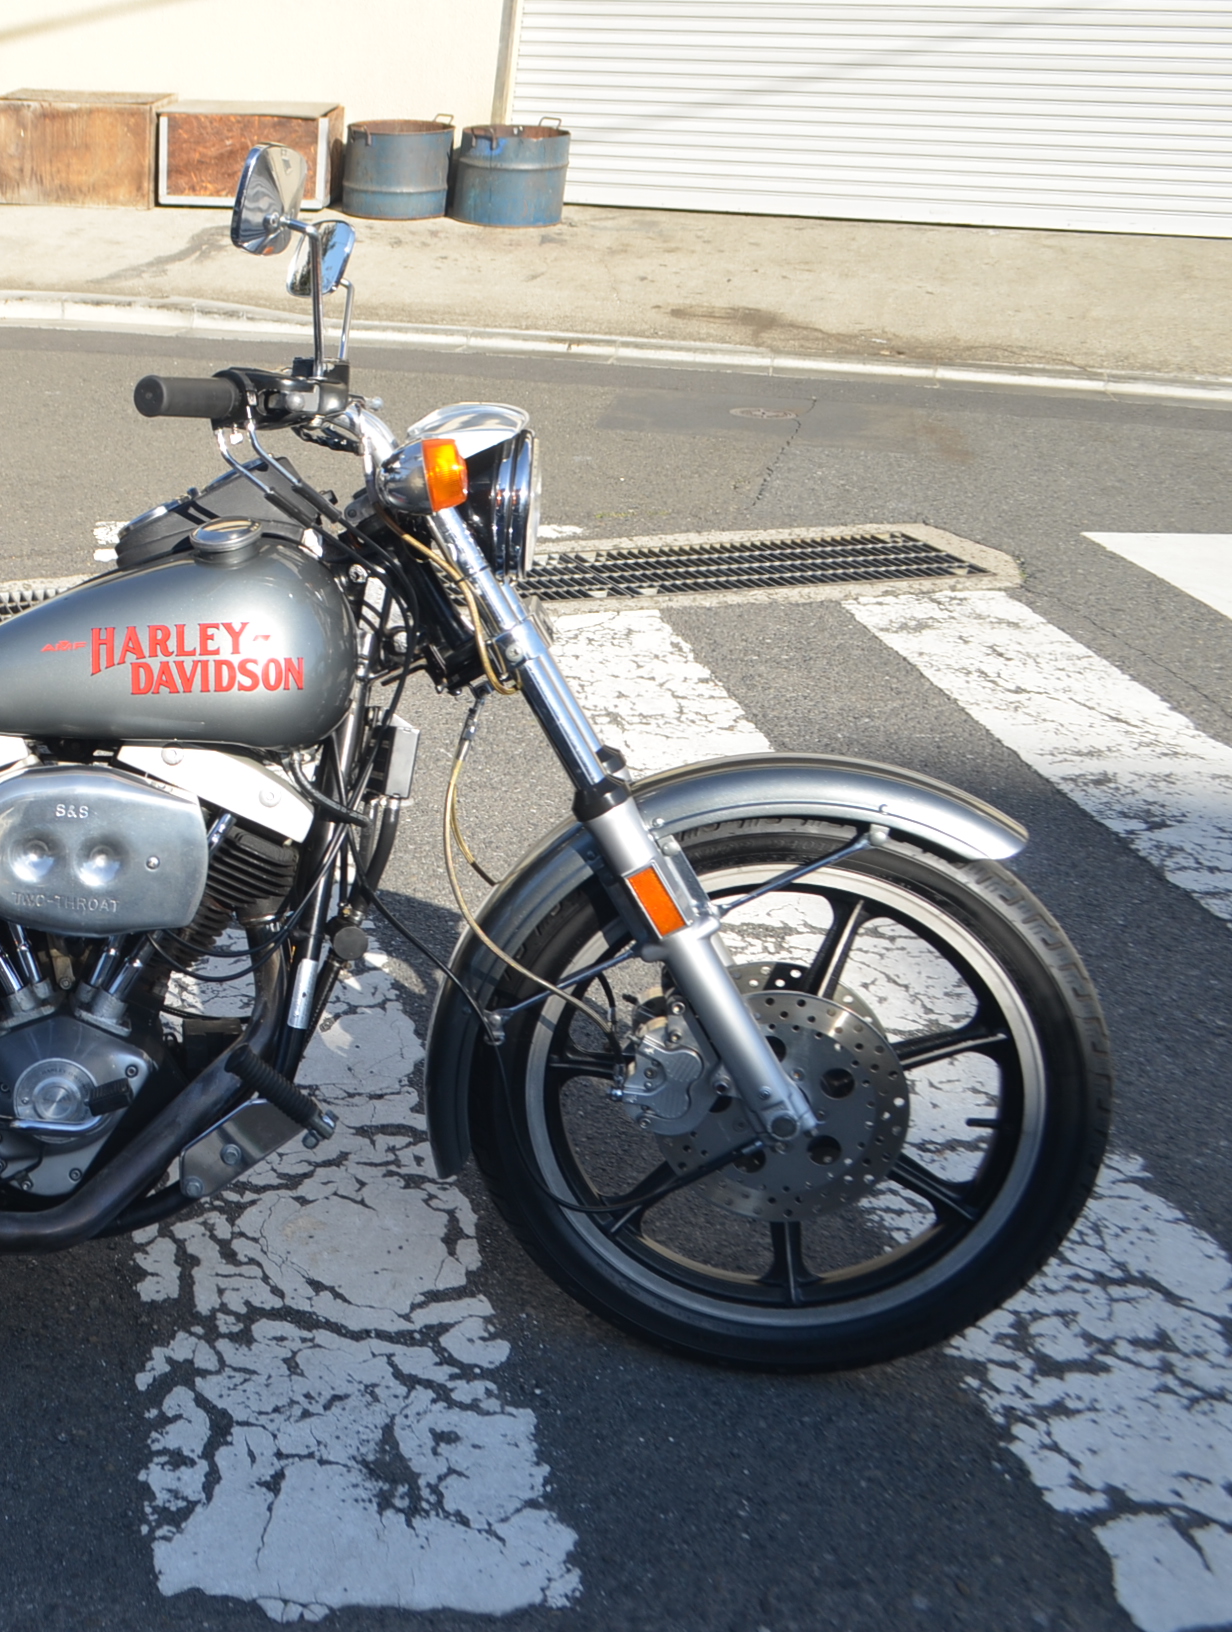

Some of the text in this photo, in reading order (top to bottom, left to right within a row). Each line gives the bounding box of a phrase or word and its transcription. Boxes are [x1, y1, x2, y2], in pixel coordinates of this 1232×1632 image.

[40, 640, 87, 652] AMF
[130, 657, 304, 695] DAVIDSON
[55, 804, 89, 819] S&S
